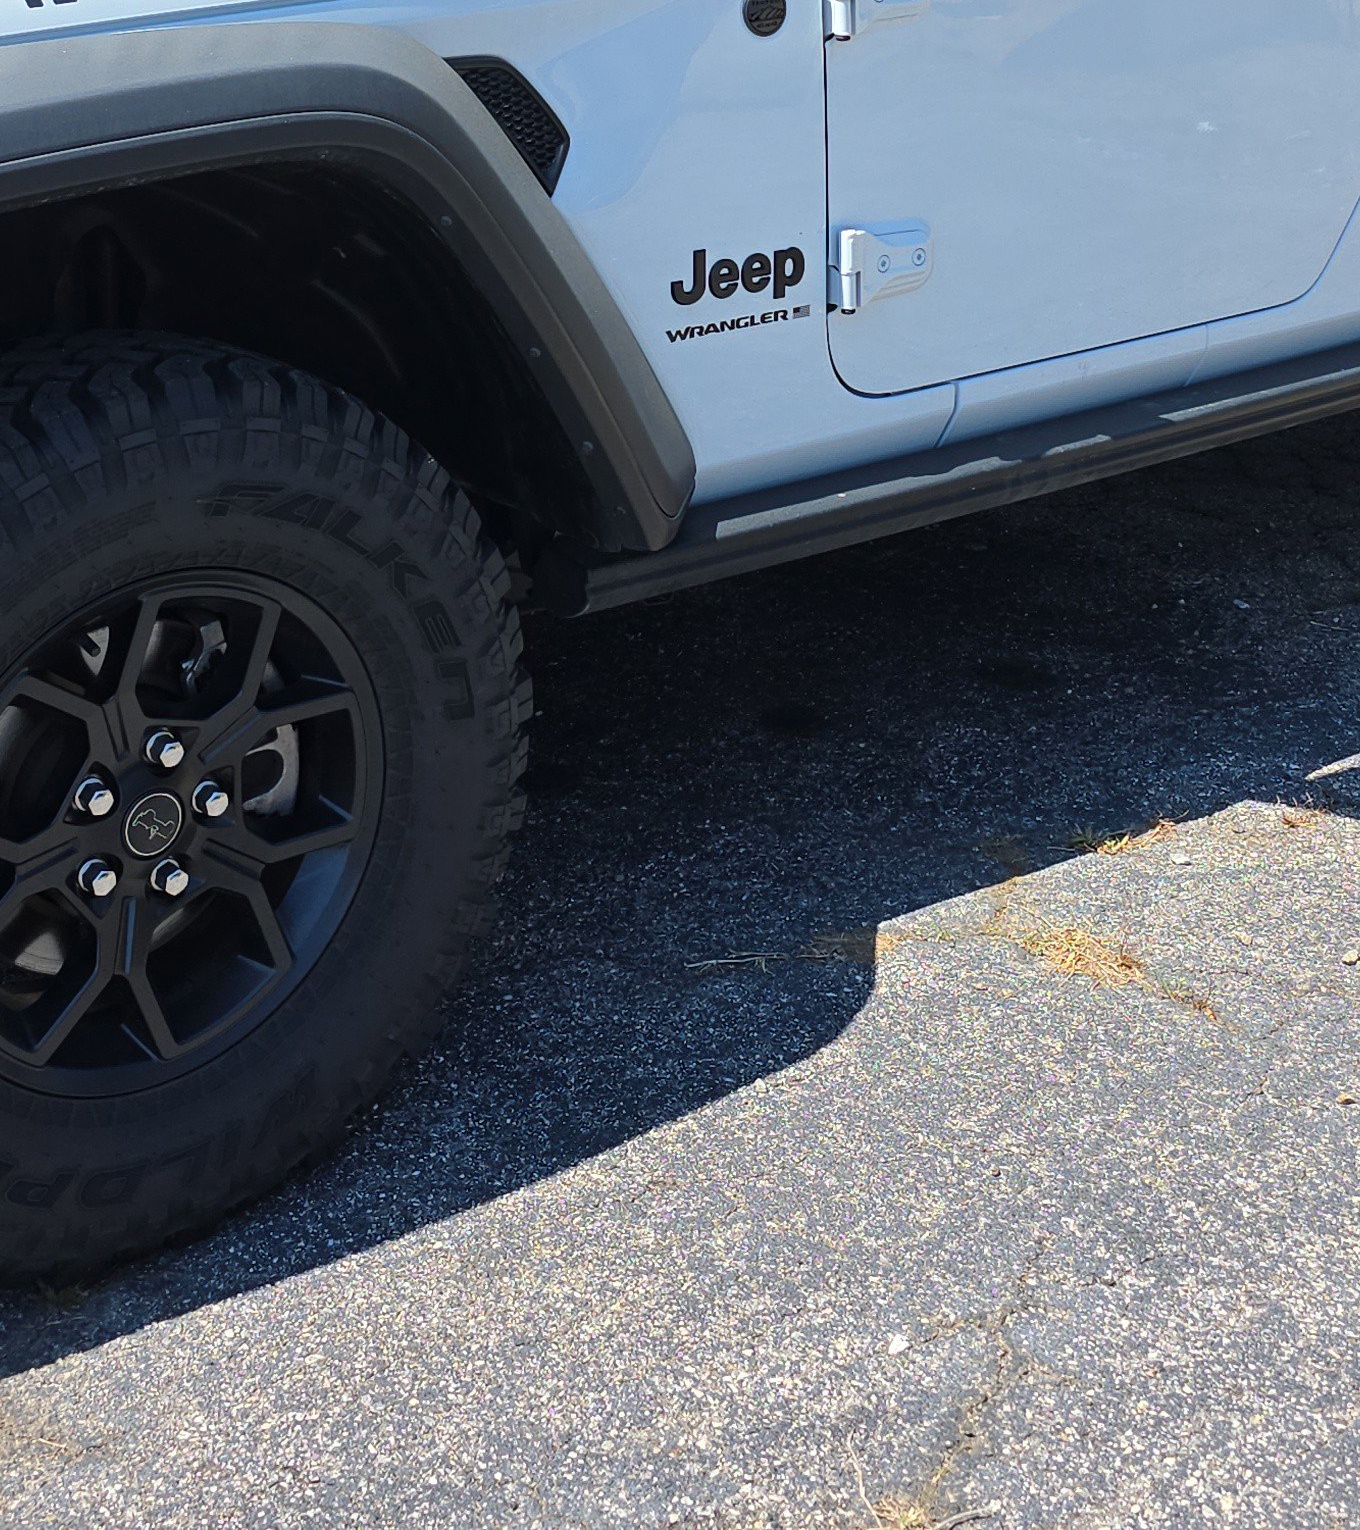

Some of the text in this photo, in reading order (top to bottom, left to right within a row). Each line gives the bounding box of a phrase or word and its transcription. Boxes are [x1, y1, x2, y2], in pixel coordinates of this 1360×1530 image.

[671, 247, 805, 305] Jeep
[665, 309, 788, 343] WRANGLER
[195, 479, 475, 722] FALKEN
